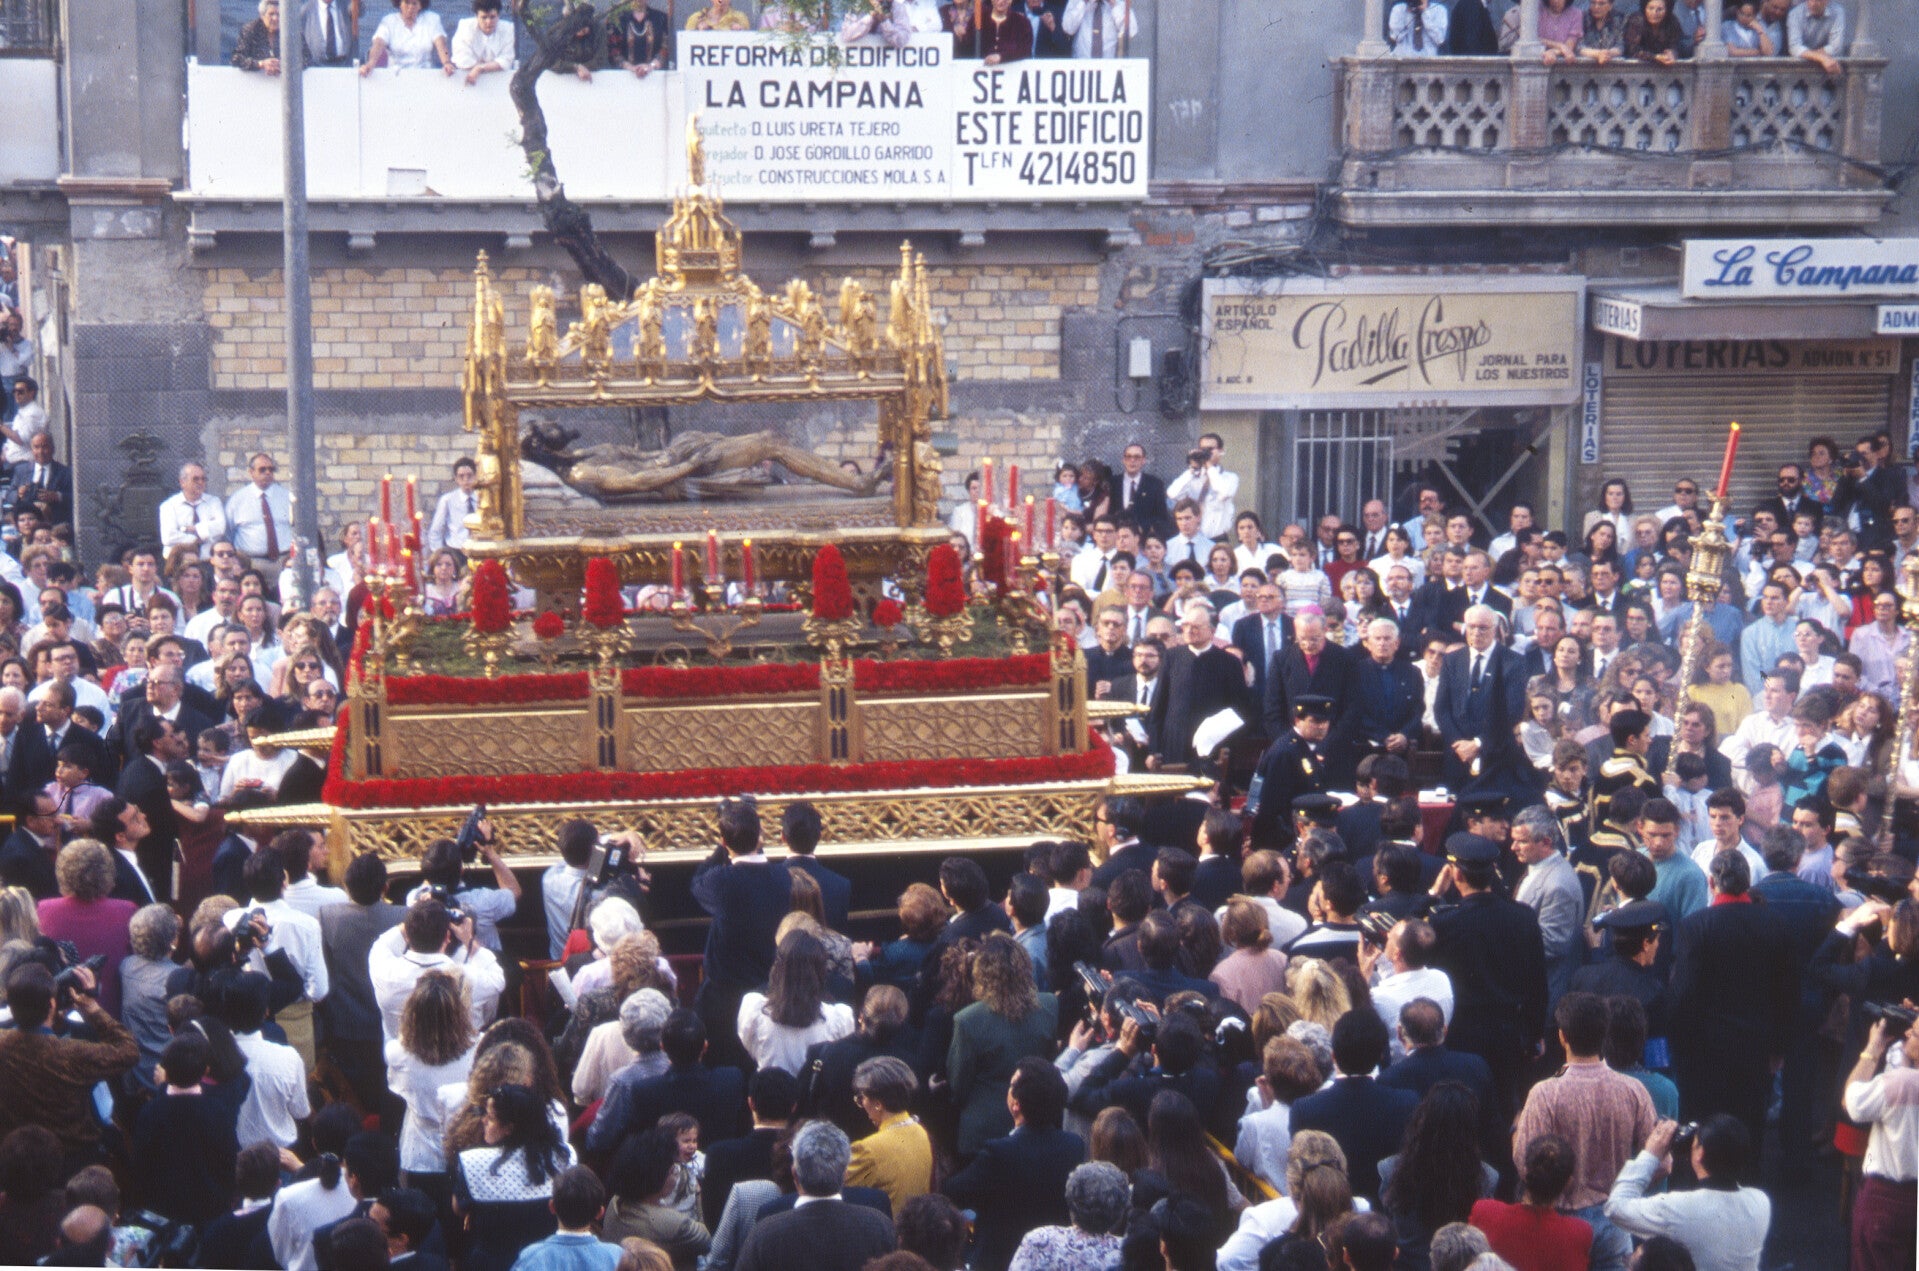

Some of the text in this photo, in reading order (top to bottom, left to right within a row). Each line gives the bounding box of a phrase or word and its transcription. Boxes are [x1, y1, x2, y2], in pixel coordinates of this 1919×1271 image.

[690, 44, 803, 67] REFORMA
[846, 46, 940, 67] EDIFICIO
[705, 80, 924, 108] LA CAMPANA
[972, 69, 1127, 107] SE ALQUILA
[767, 121, 796, 136] LUIS
[800, 121, 844, 136] URETA
[849, 121, 900, 136] TEJERO
[956, 111, 1022, 145] ESTE
[1034, 110, 1142, 144] EDIFICIO
[769, 145, 801, 160] JOSE
[805, 145, 870, 160] GORDILLO
[875, 145, 933, 160] GARRIDO
[759, 169, 879, 184] CONSTRUCCIONES
[1019, 151, 1136, 186] 4214850
[1704, 244, 1919, 290] La Campana
[1215, 304, 1277, 317] ARTICULO
[1291, 294, 1492, 388] Padilla Crespo
[1479, 353, 1567, 367] JORNAL PARA
[1475, 367, 1569, 381] LOS NUESTROS
[1584, 365, 1599, 461] LOTERIAS
